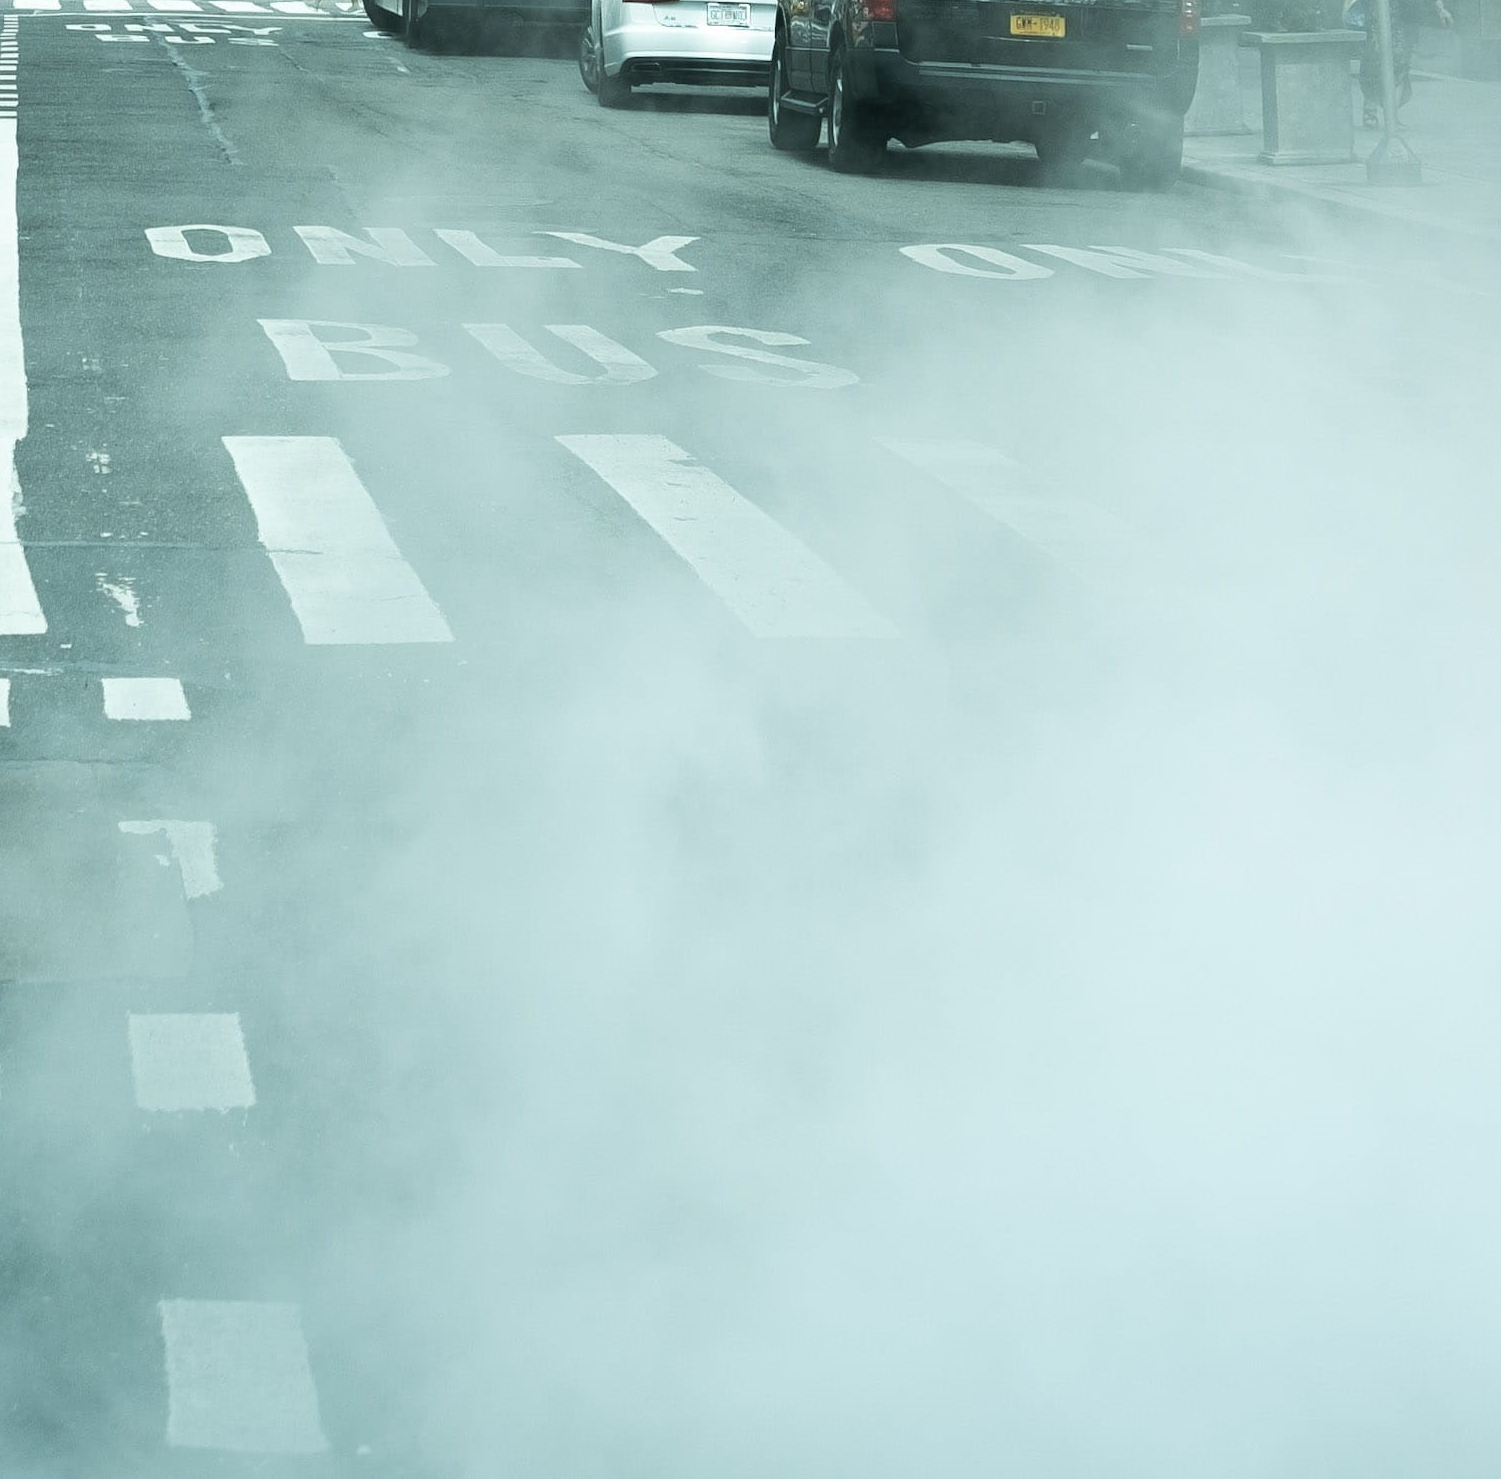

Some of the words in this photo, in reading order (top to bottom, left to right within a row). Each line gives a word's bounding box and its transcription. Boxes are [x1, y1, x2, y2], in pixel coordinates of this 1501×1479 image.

[65, 21, 283, 36] ONLY
[95, 33, 280, 47] BUS
[143, 224, 702, 272] ONLY
[255, 318, 861, 389] BUS
